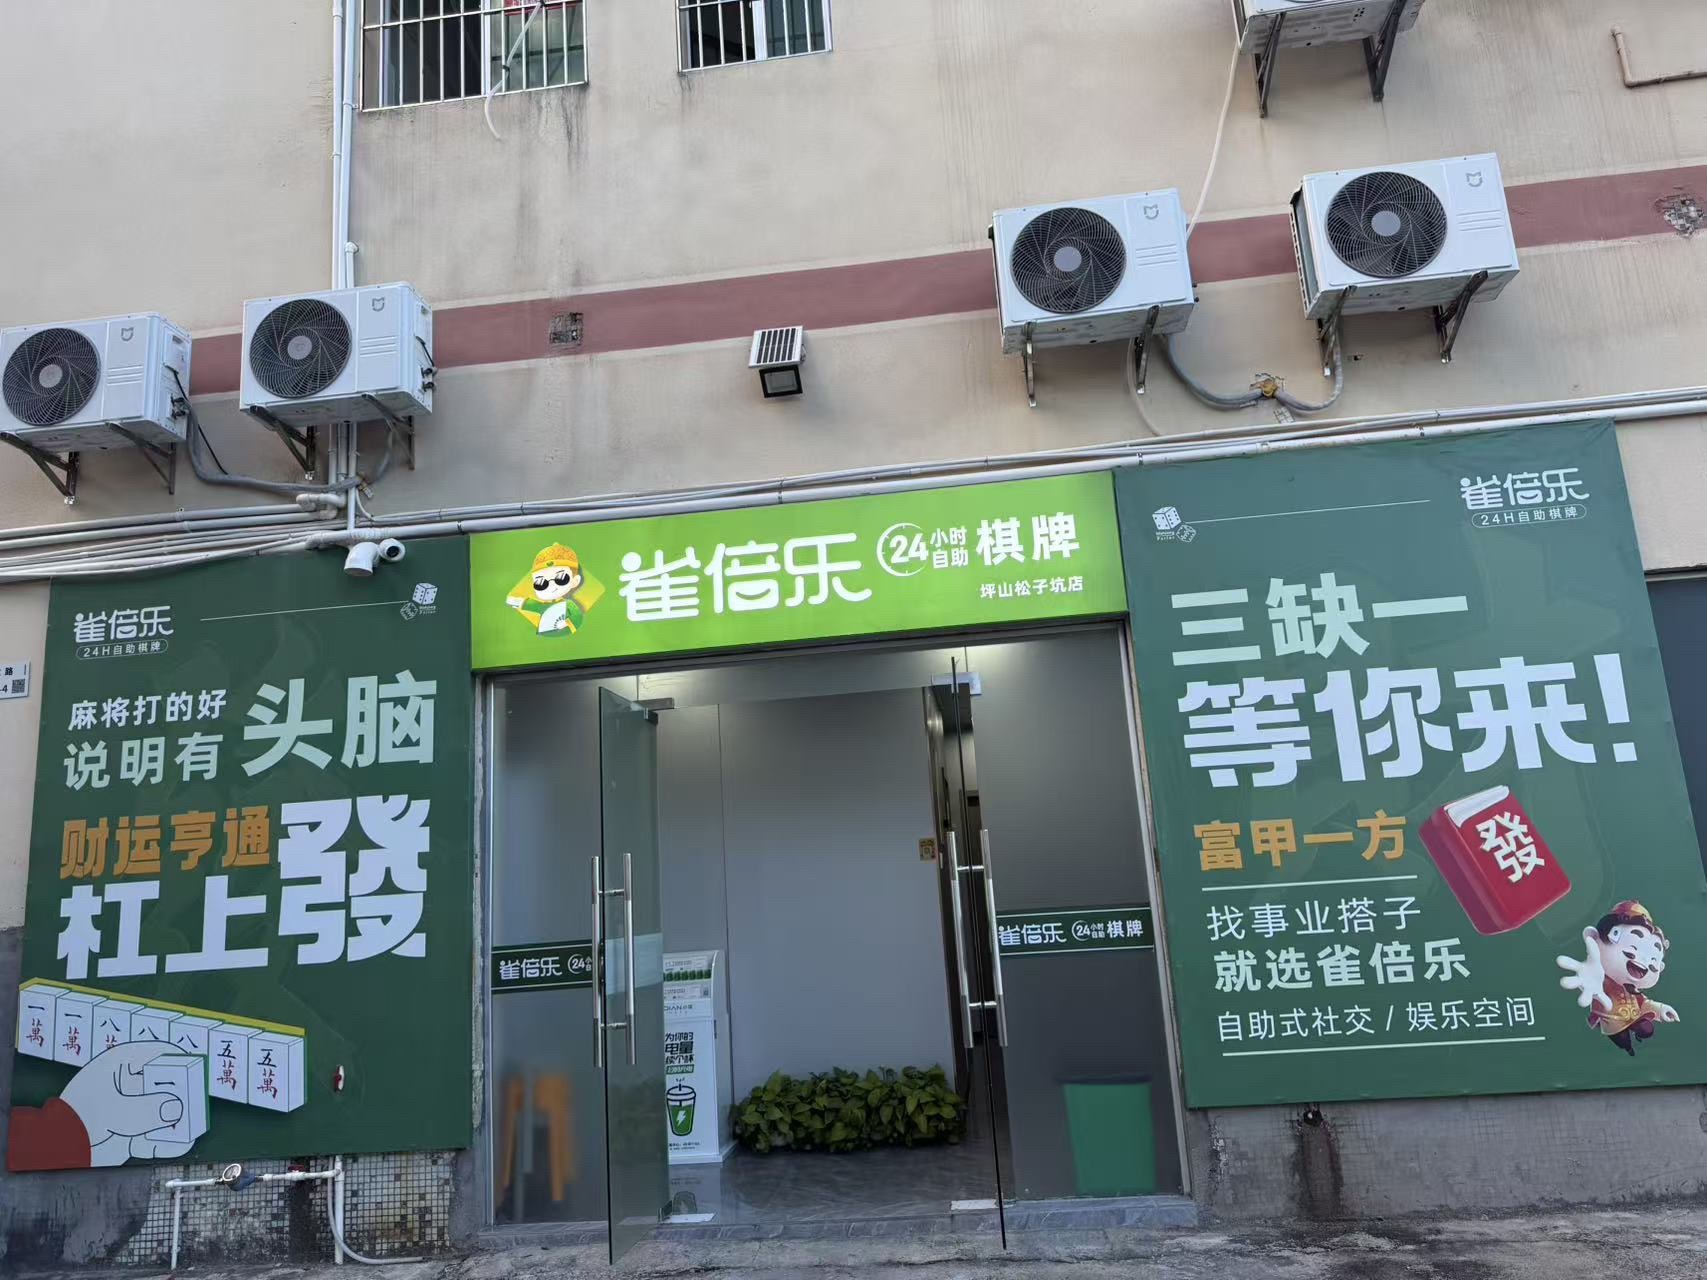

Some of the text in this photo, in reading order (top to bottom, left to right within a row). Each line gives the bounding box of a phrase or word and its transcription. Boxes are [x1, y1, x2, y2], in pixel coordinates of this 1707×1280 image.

[930, 526, 967, 547] 小时
[975, 512, 1080, 566] 棋牌
[1481, 505, 1578, 526] 24H自助棋牌
[932, 548, 969, 568] 自助
[979, 576, 1083, 599] 坪山松子坑店
[1170, 572, 1468, 666] 三缺一
[83, 642, 162, 659] 24H自助棋牌
[63, 669, 437, 791] 说明有 头脑
[68, 689, 227, 731] 麻将打的好
[1178, 653, 1637, 787] 等你来!
[60, 805, 270, 880] 财运亨通
[1194, 809, 1406, 871] 富甲一方
[1476, 811, 1545, 883] 發
[1107, 920, 1144, 938] 棋牌
[1206, 897, 1421, 941] 找事业搭子
[1213, 937, 1471, 994] 就选雀倍乐
